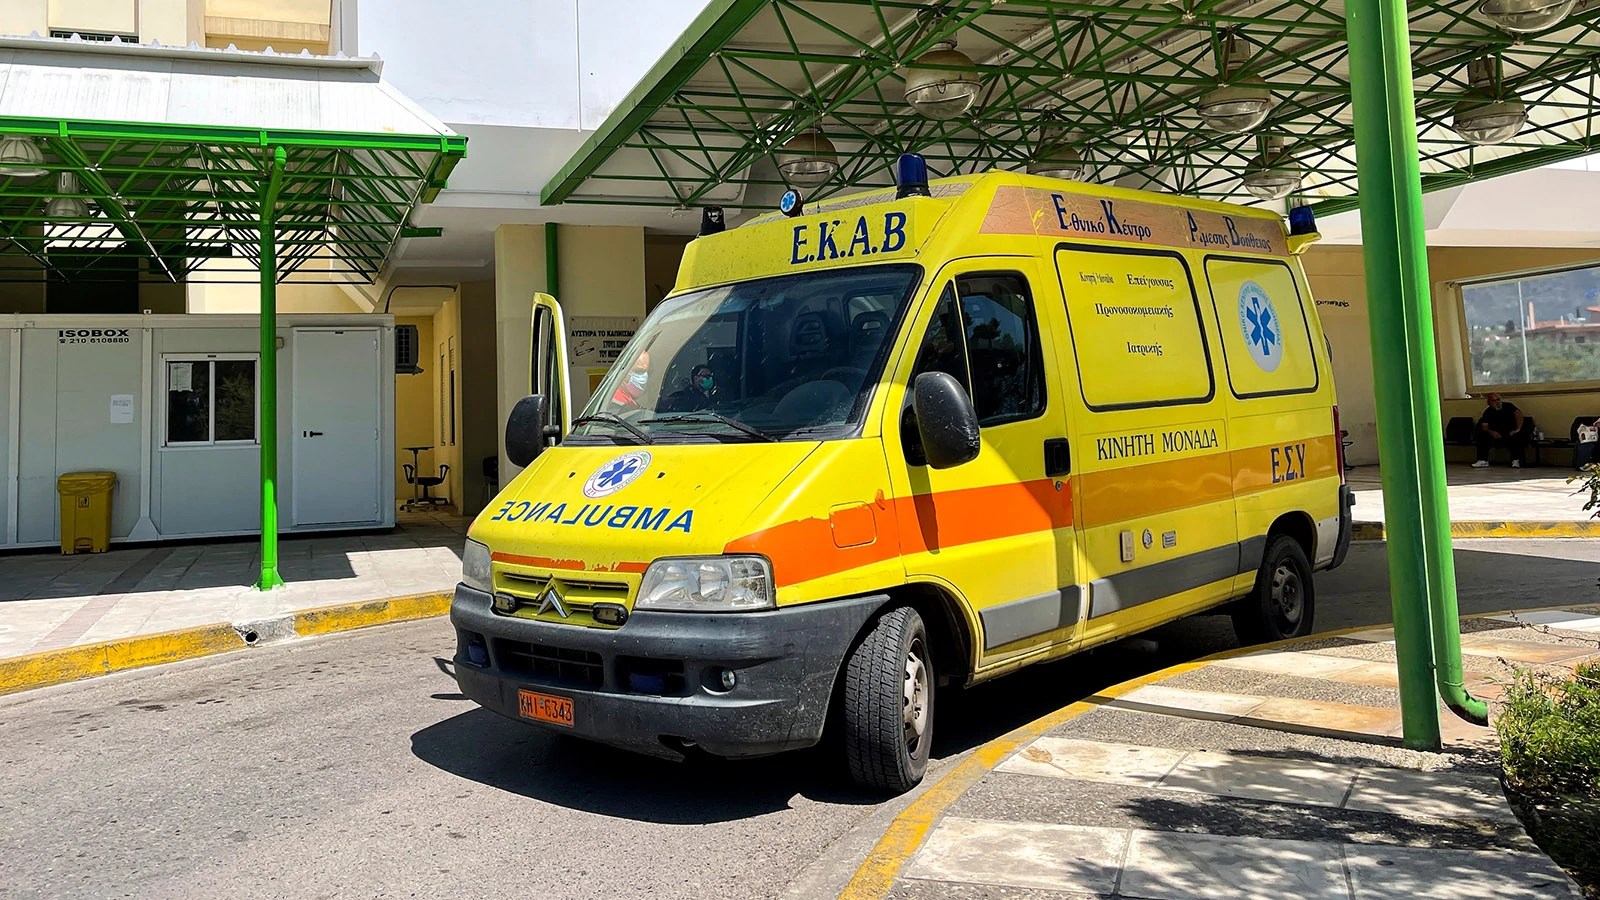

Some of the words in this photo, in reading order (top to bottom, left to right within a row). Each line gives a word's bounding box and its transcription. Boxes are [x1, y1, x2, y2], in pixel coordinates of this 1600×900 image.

[1051, 193, 1105, 233] Εθνικό
[1100, 199, 1151, 240] Κέντρο
[1127, 273, 1174, 289] Επείγουσας
[58, 329, 129, 338] ISOBOX
[597, 330, 606, 338] ΤΟ
[1127, 342, 1163, 356] Ιατρικής
[1097, 433, 1154, 460] ΚΙΝΗΤΗ
[1162, 428, 1219, 453] ΜΟΝΑΔΑ
[1271, 443, 1306, 483] Ε.Σ.Υ
